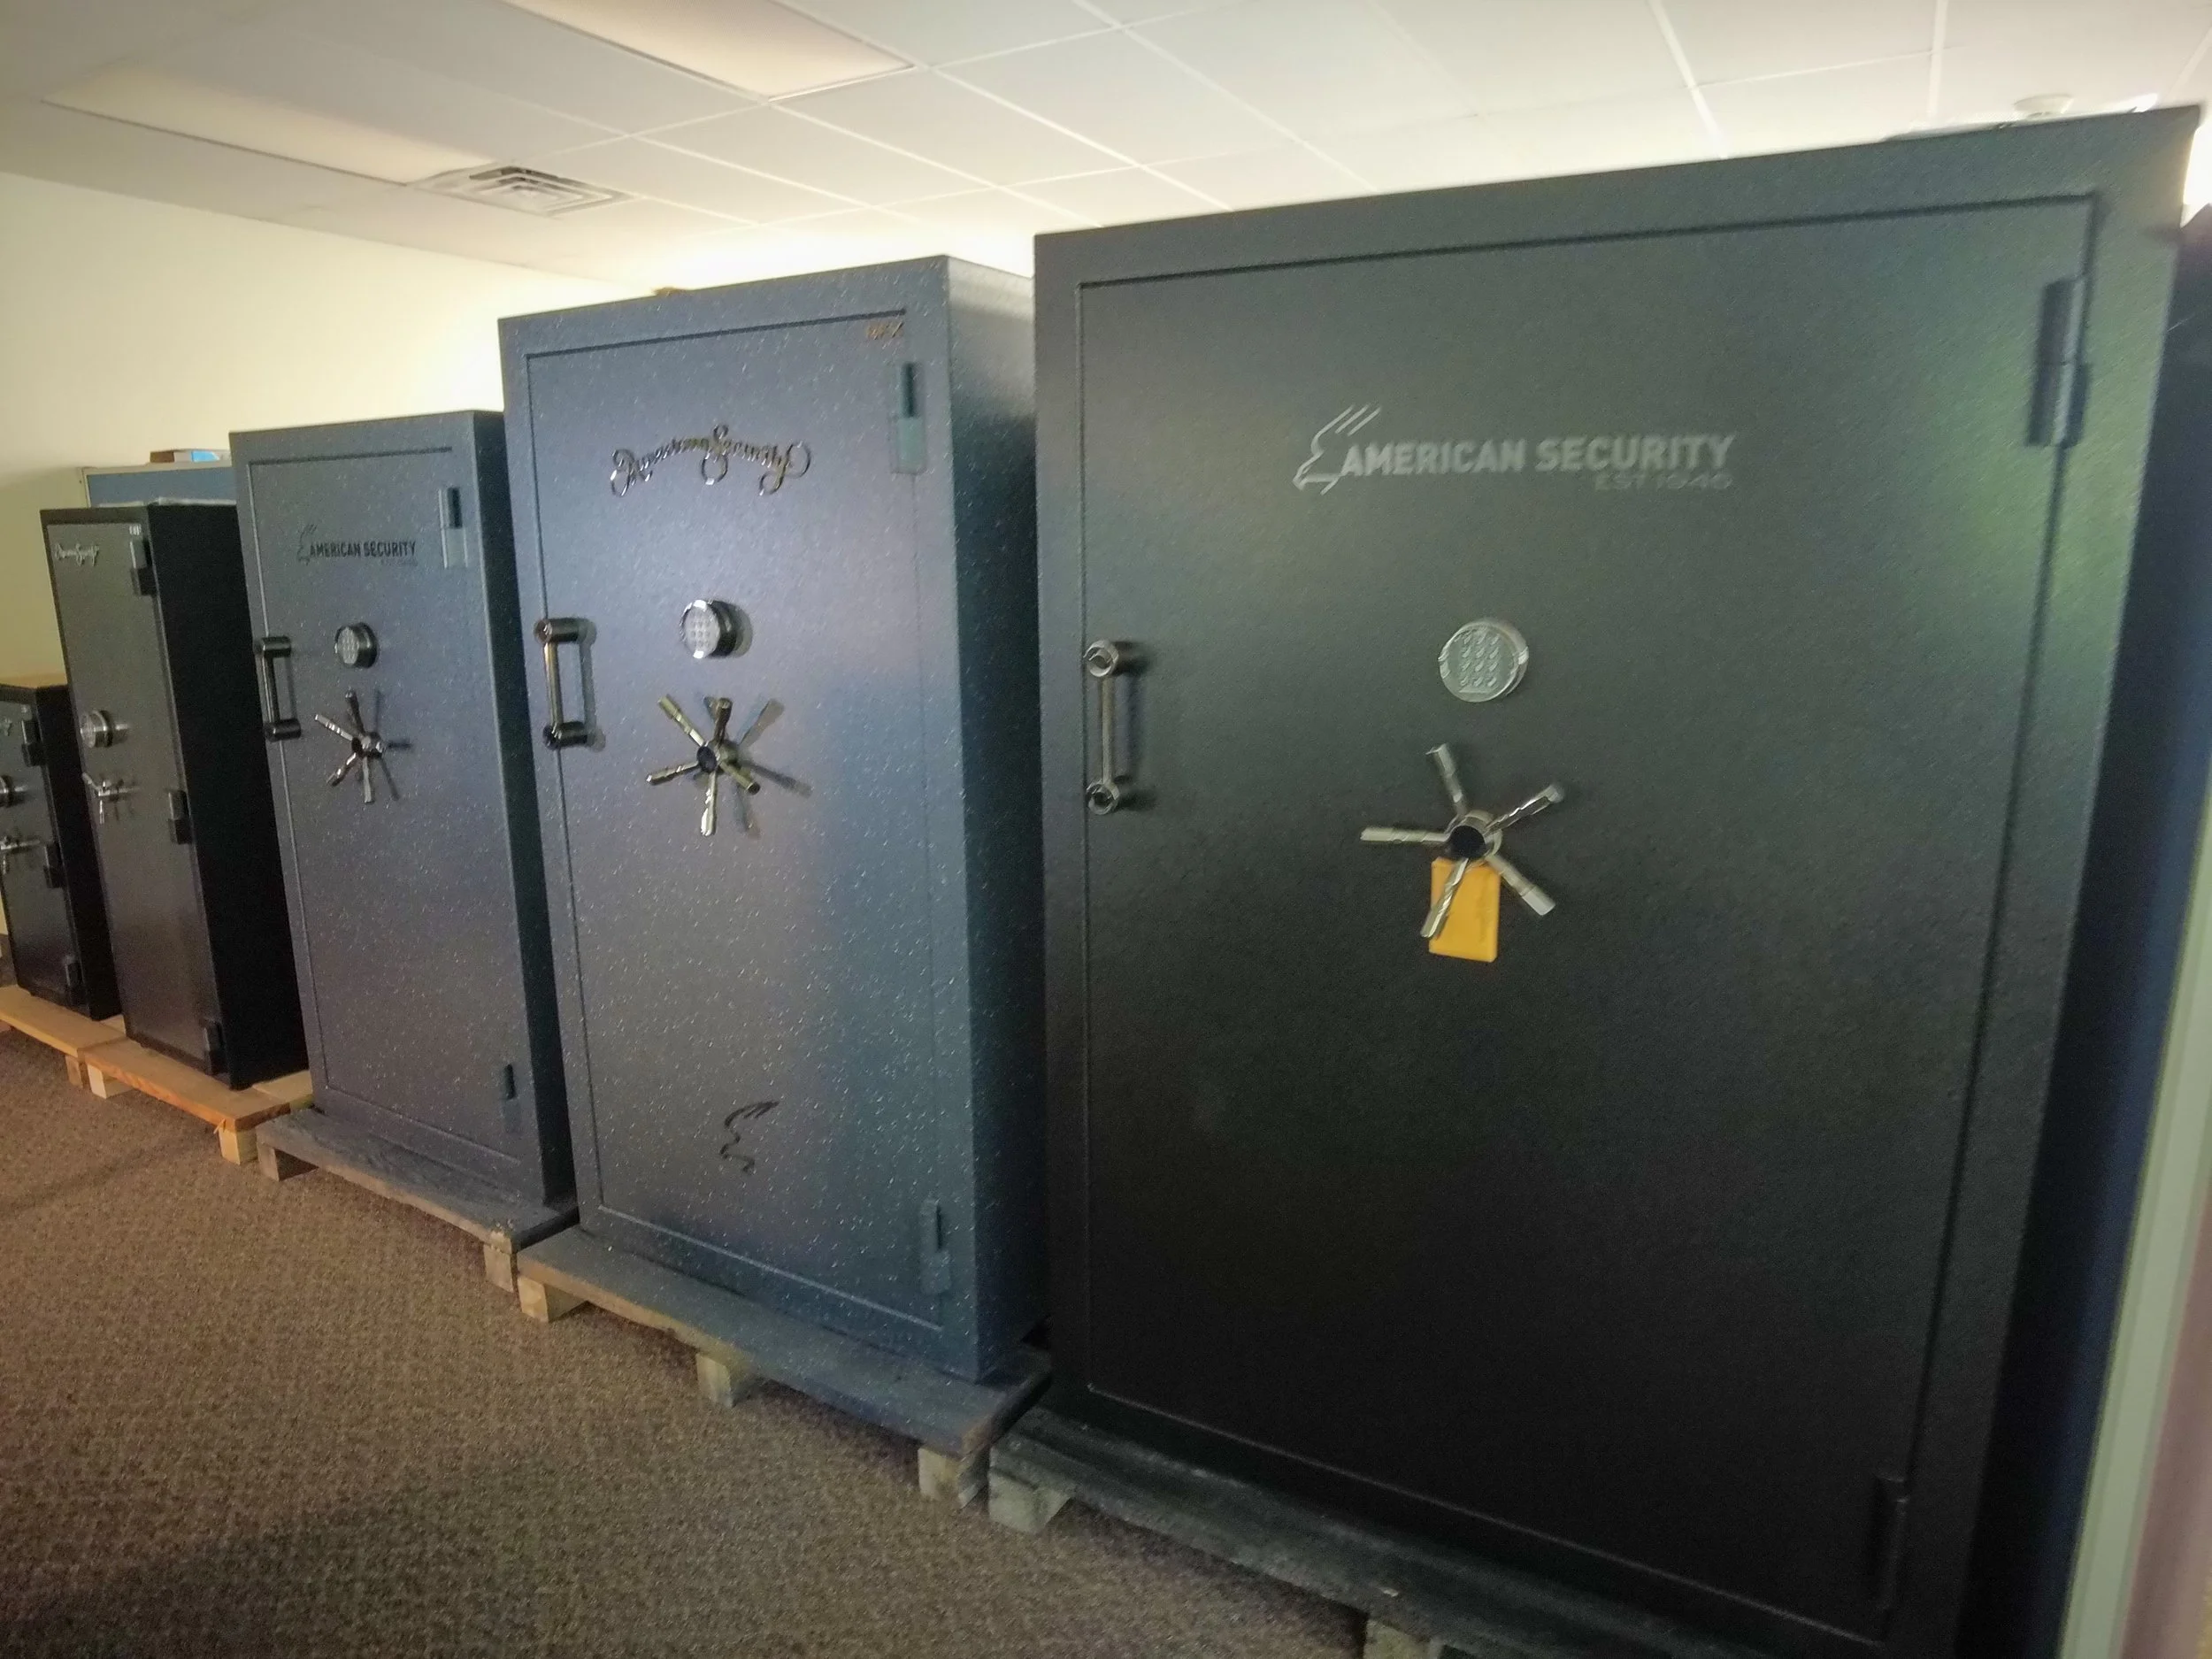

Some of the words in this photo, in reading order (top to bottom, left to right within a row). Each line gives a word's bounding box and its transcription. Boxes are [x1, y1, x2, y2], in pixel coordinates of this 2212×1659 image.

[1340, 439, 1526, 477] AMERICAN
[1534, 431, 1736, 472] SECURITY
[310, 541, 362, 558] AMERICAN
[363, 540, 417, 557] SECURITY
